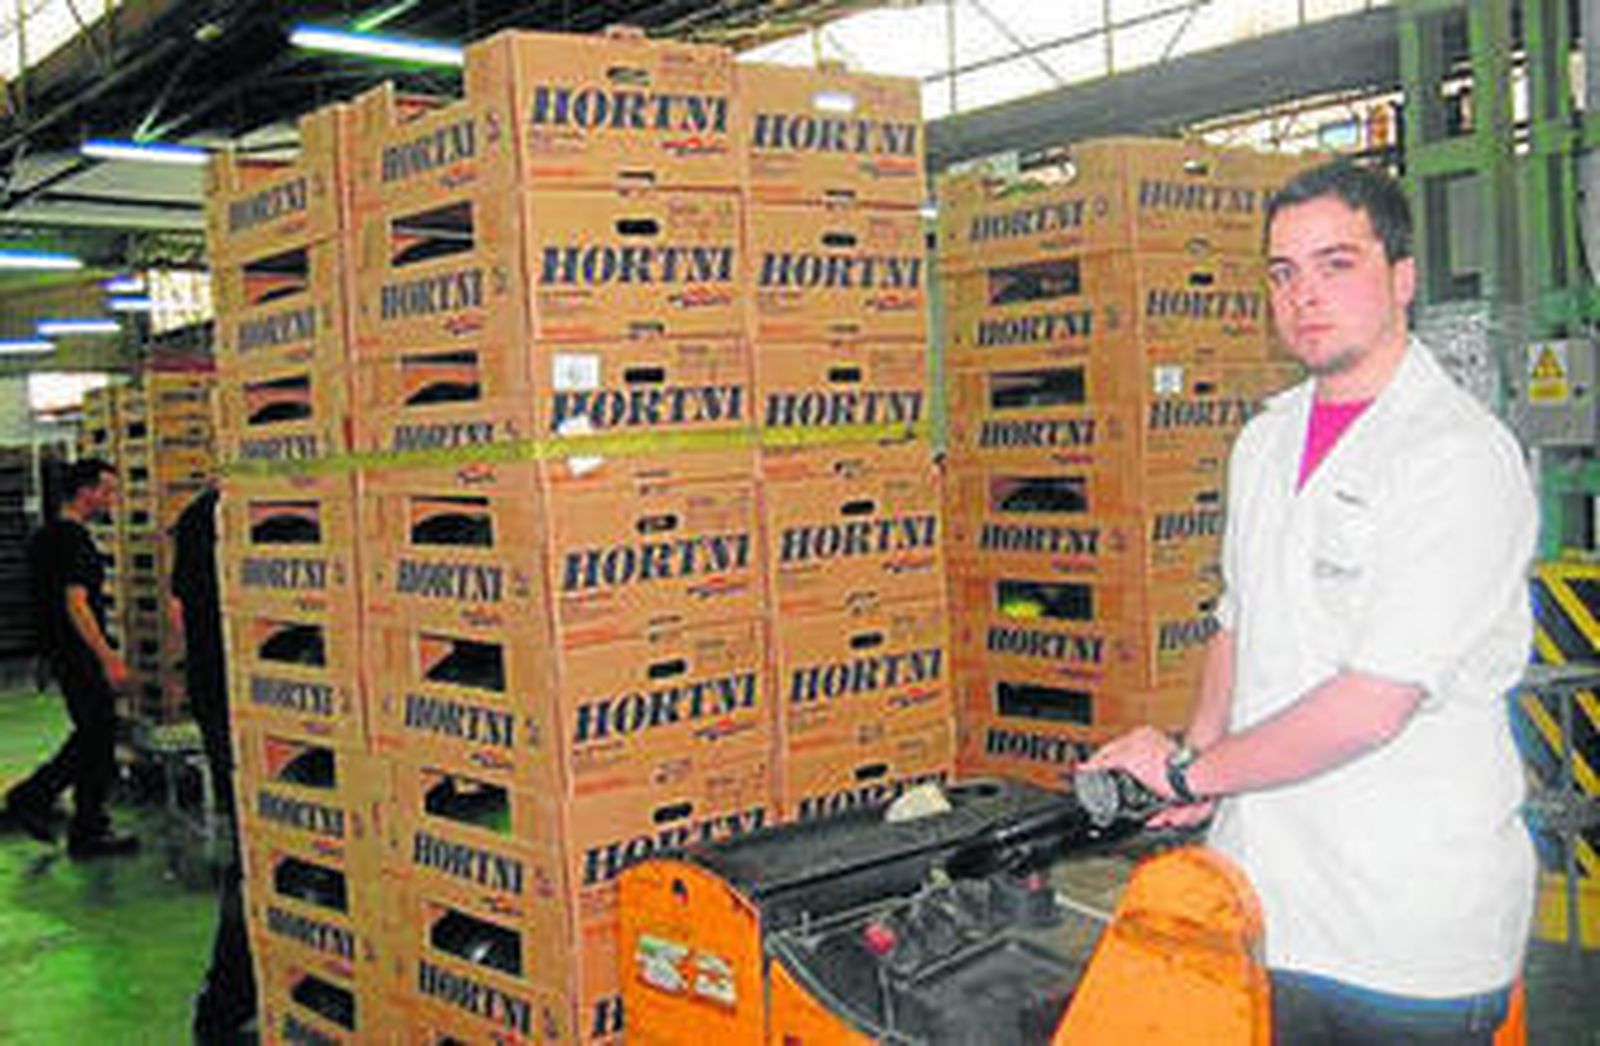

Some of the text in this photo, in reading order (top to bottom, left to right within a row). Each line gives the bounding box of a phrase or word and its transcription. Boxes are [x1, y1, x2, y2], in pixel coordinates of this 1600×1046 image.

[531, 86, 728, 133] HORTNI
[381, 119, 476, 183] HORTNI
[751, 114, 917, 155] HORTNI
[970, 199, 1084, 241] HORTNI
[541, 245, 734, 284] HORTNI
[759, 253, 923, 288] HORTNI
[381, 269, 483, 320] HORTNI
[1146, 289, 1260, 319] HORTNI
[977, 310, 1093, 346] HORTNI
[766, 390, 923, 428] HORTNI
[979, 419, 1097, 448] HORTNI
[780, 515, 937, 562] HORTNI
[981, 524, 1100, 555] HORTNI
[1153, 513, 1223, 541] HOR
[397, 559, 503, 603] HORTNI
[563, 535, 750, 591] HORTNI
[987, 627, 1103, 665] HORTNI
[1159, 613, 1221, 651] HOR
[790, 649, 943, 703] HORTNI
[405, 693, 515, 748] HORTNI
[573, 673, 756, 743] HORTNI
[987, 727, 1094, 763] HORTN
[414, 831, 522, 895] HORTNI
[419, 958, 531, 1034] HORTNI
